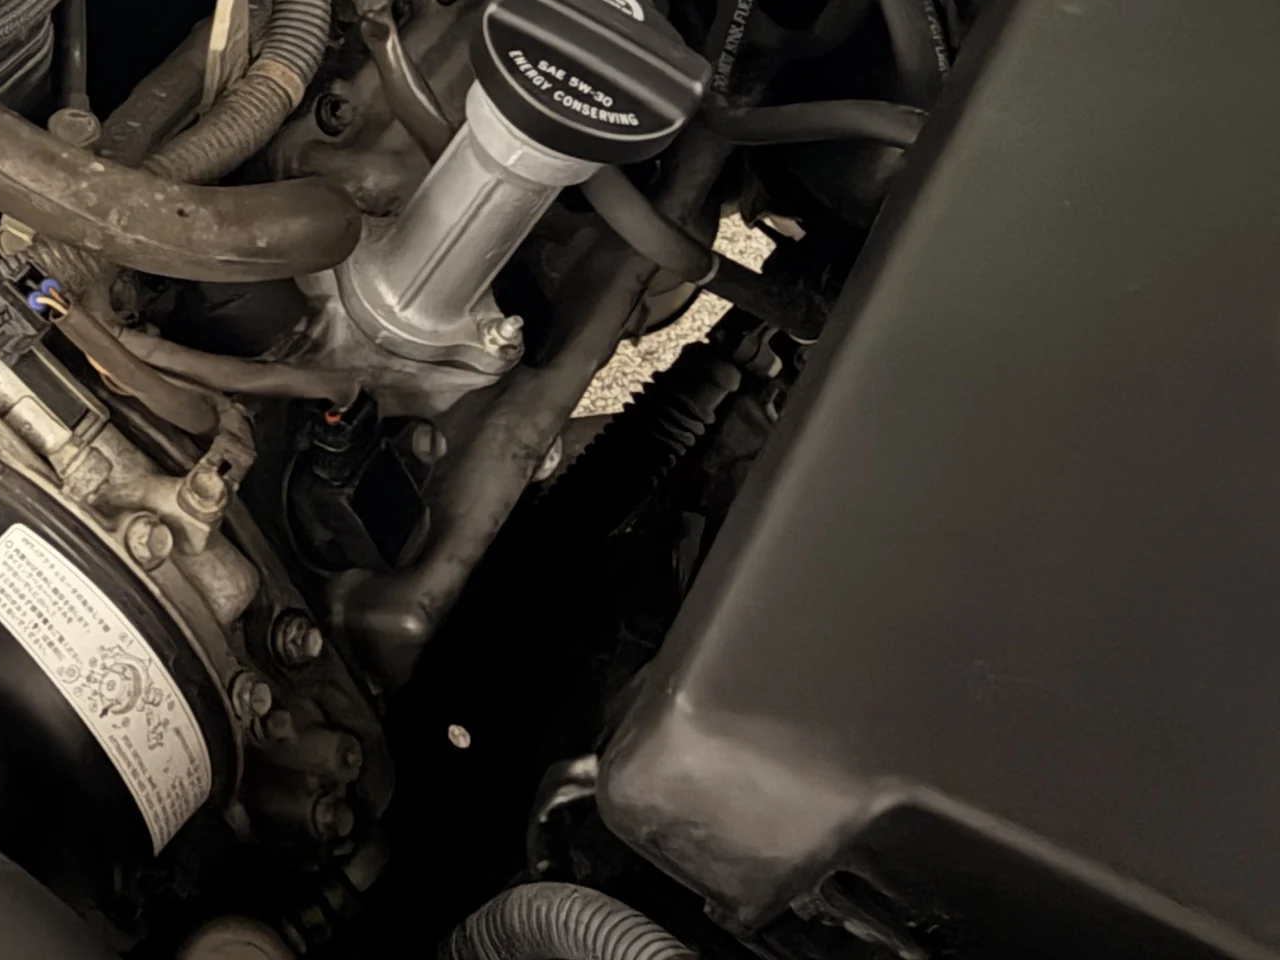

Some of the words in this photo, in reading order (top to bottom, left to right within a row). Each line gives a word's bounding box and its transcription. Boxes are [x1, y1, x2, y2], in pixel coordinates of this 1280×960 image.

[508, 49, 553, 91] ENERGY
[553, 90, 640, 127] CONSERVING
[537, 59, 567, 81] SAE
[568, 76, 613, 107] 5W-30
